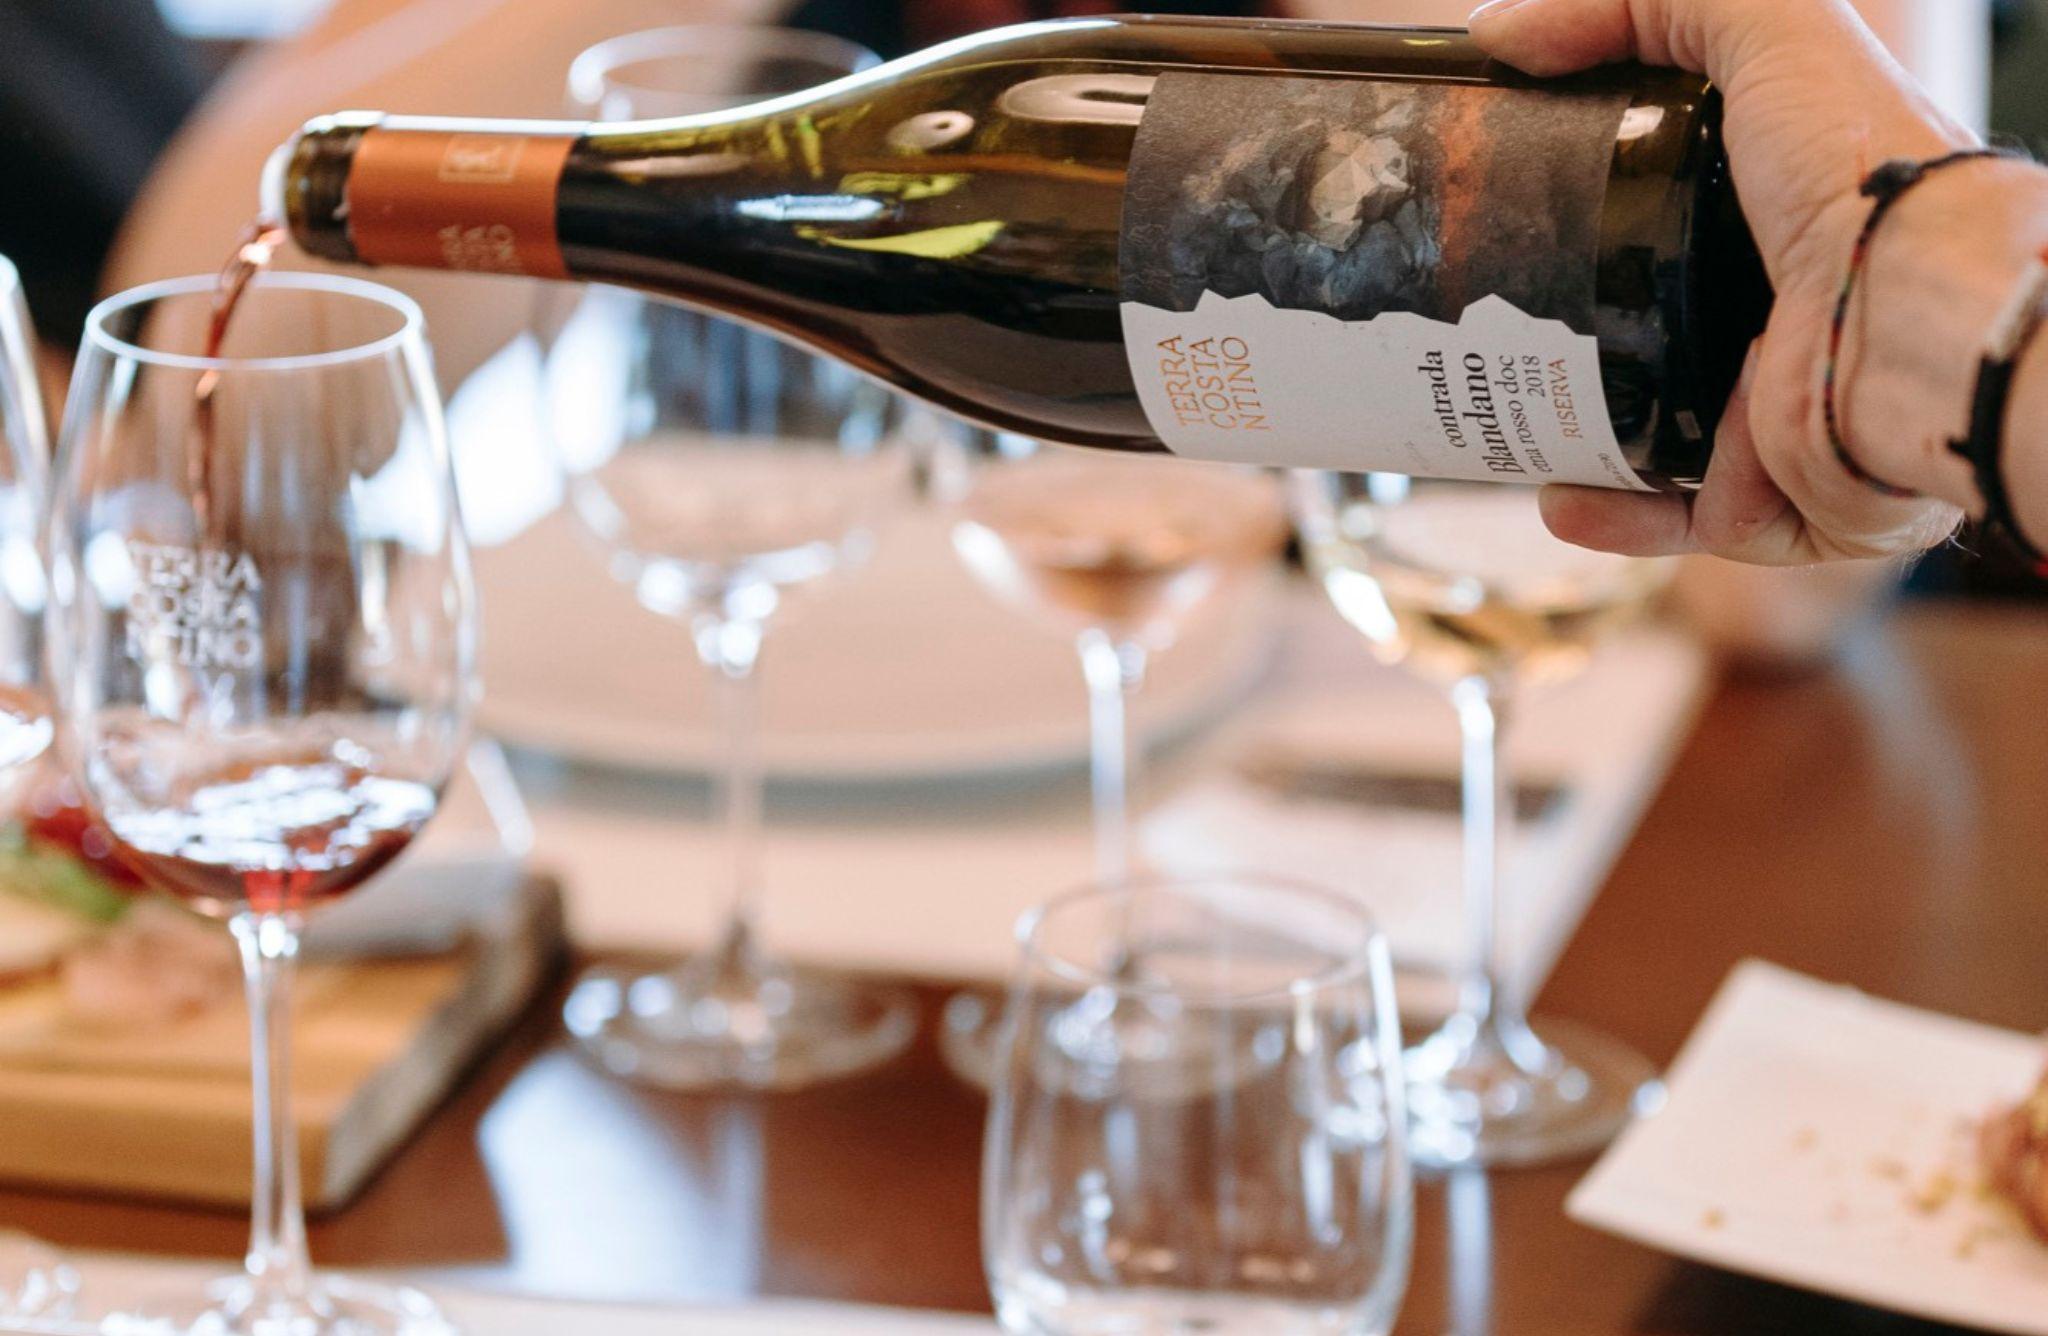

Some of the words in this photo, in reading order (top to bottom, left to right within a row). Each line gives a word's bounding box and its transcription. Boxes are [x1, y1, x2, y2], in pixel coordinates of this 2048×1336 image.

[1157, 335, 1204, 426] TERRA
[1189, 337, 1237, 429] COSTA
[1220, 337, 1275, 430] NTINO
[1418, 351, 1467, 448] contrada
[1462, 353, 1527, 475] Blandano
[1494, 355, 1520, 394] doc
[1522, 355, 1546, 398] 2018
[1547, 358, 1583, 440] RISERVA
[1508, 400, 1535, 446] rosso
[1525, 448, 1553, 473] etna
[126, 541, 262, 594] TERRA
